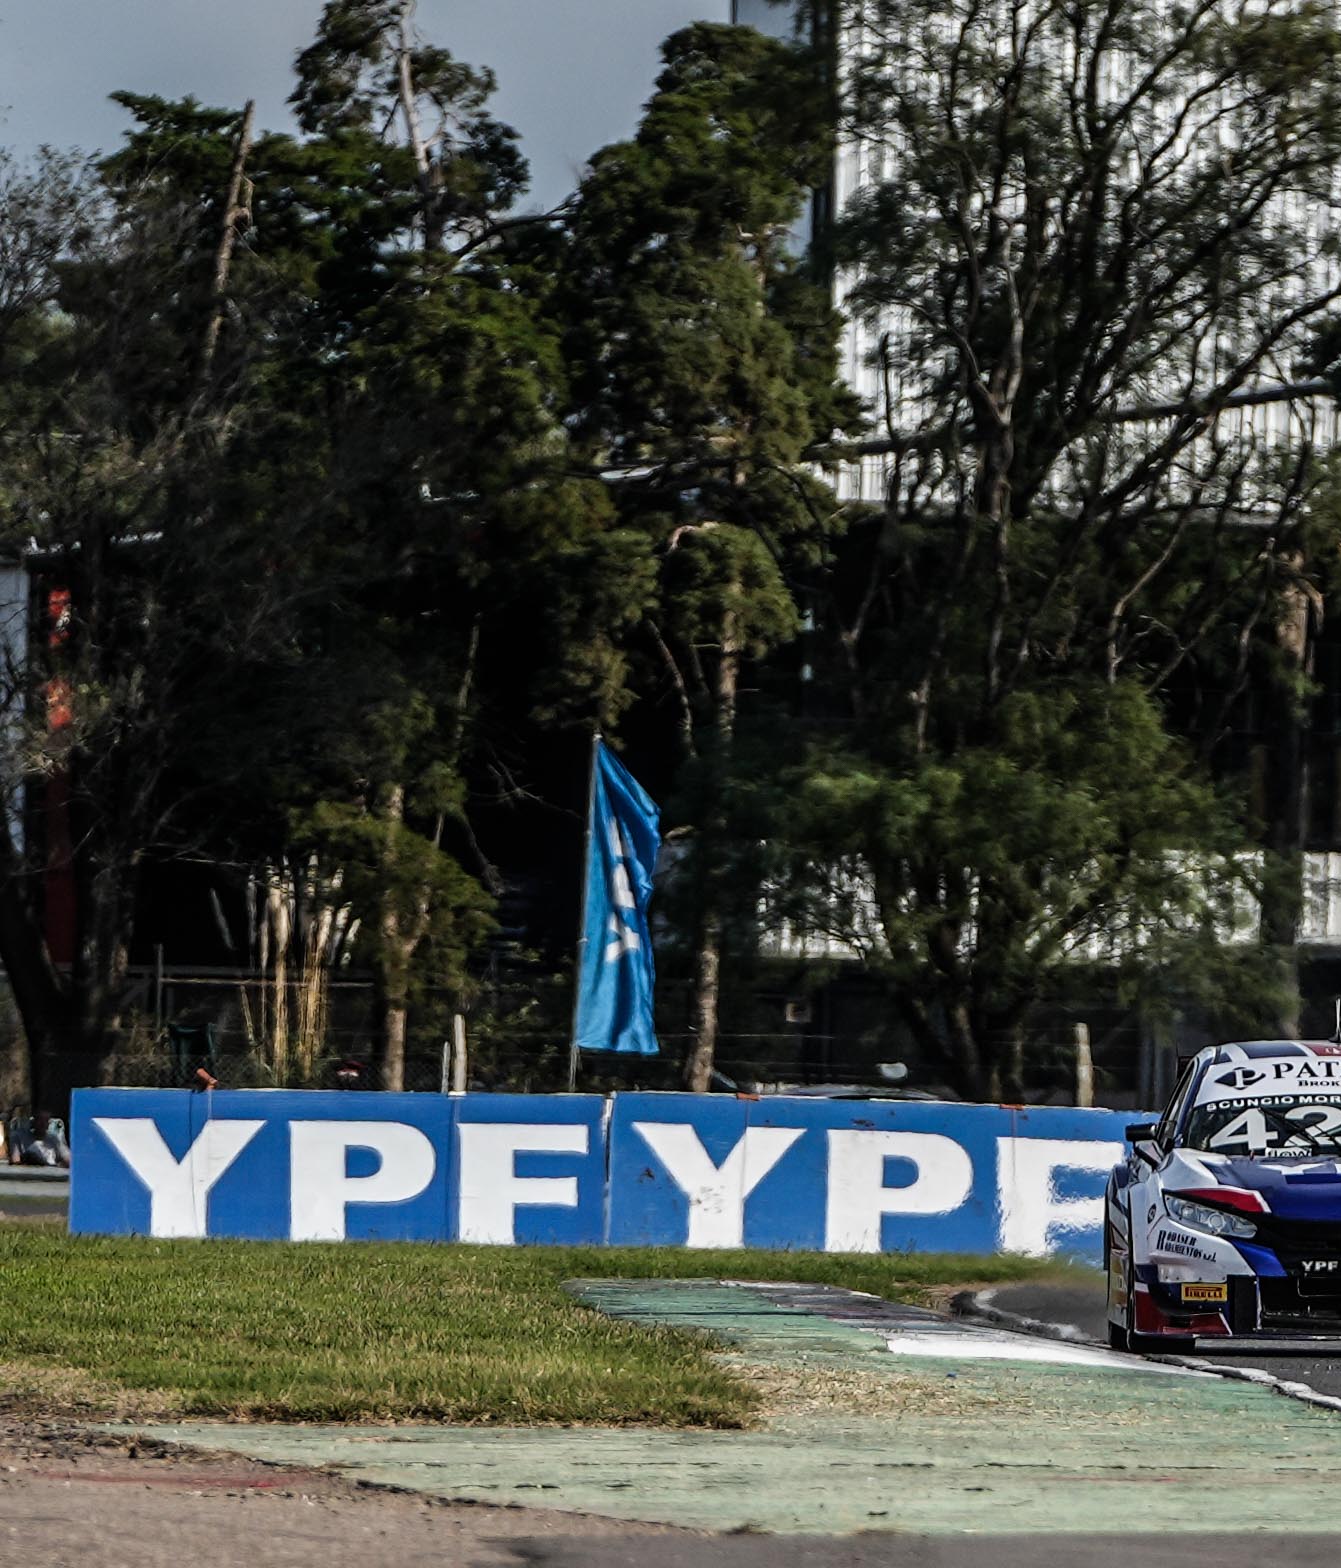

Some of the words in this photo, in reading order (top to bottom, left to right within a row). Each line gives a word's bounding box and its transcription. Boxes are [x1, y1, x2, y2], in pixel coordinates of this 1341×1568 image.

[1206, 1095, 1294, 1112] SCUNCIO
[91, 1117, 589, 1245] YPF
[632, 1121, 1126, 1257] YPF
[1302, 1261, 1339, 1272] YPF
[1184, 1286, 1224, 1298] PIRELLI
